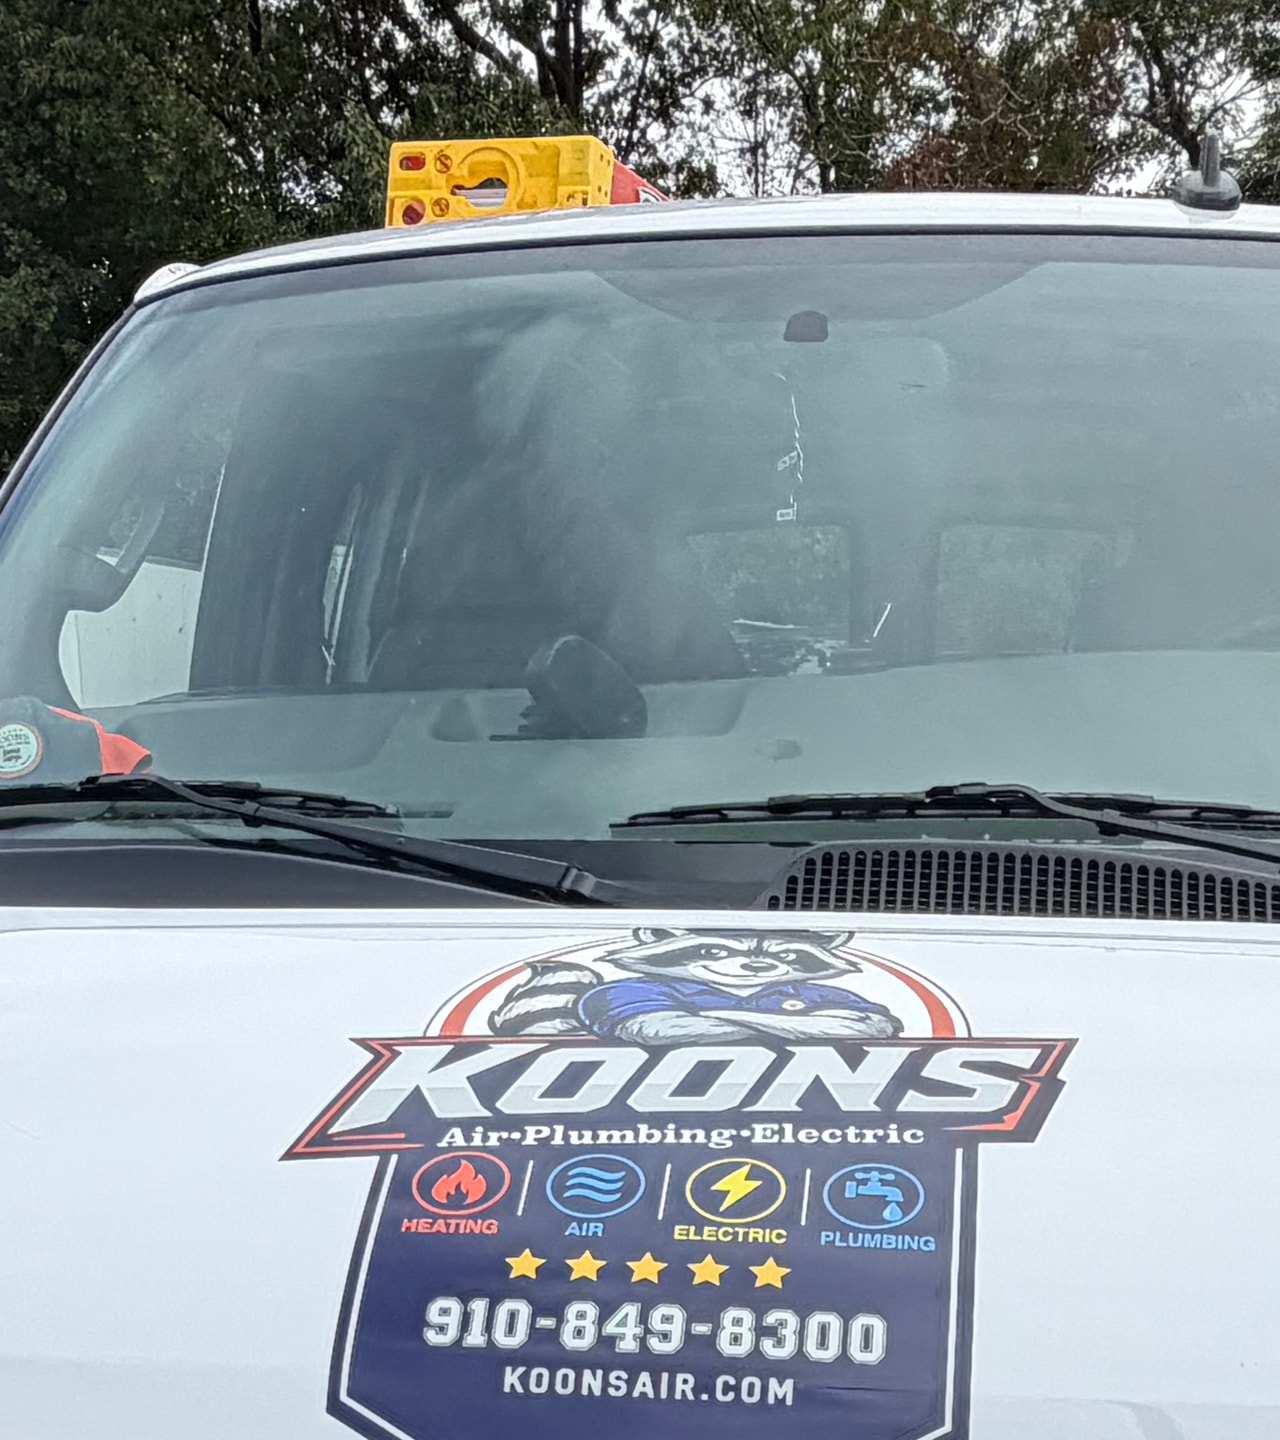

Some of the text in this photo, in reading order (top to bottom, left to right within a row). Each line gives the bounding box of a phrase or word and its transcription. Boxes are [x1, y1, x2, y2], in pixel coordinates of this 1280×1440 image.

[331, 1043, 1042, 1136] KOONS
[400, 1218, 500, 1235] HEATING
[564, 1221, 604, 1238] AIR
[673, 1224, 788, 1245] ELECTRIC
[820, 1230, 936, 1252] PLUMBING
[422, 1295, 888, 1366] 910-849-8300
[503, 1365, 796, 1406] KOONSAIR.COM
